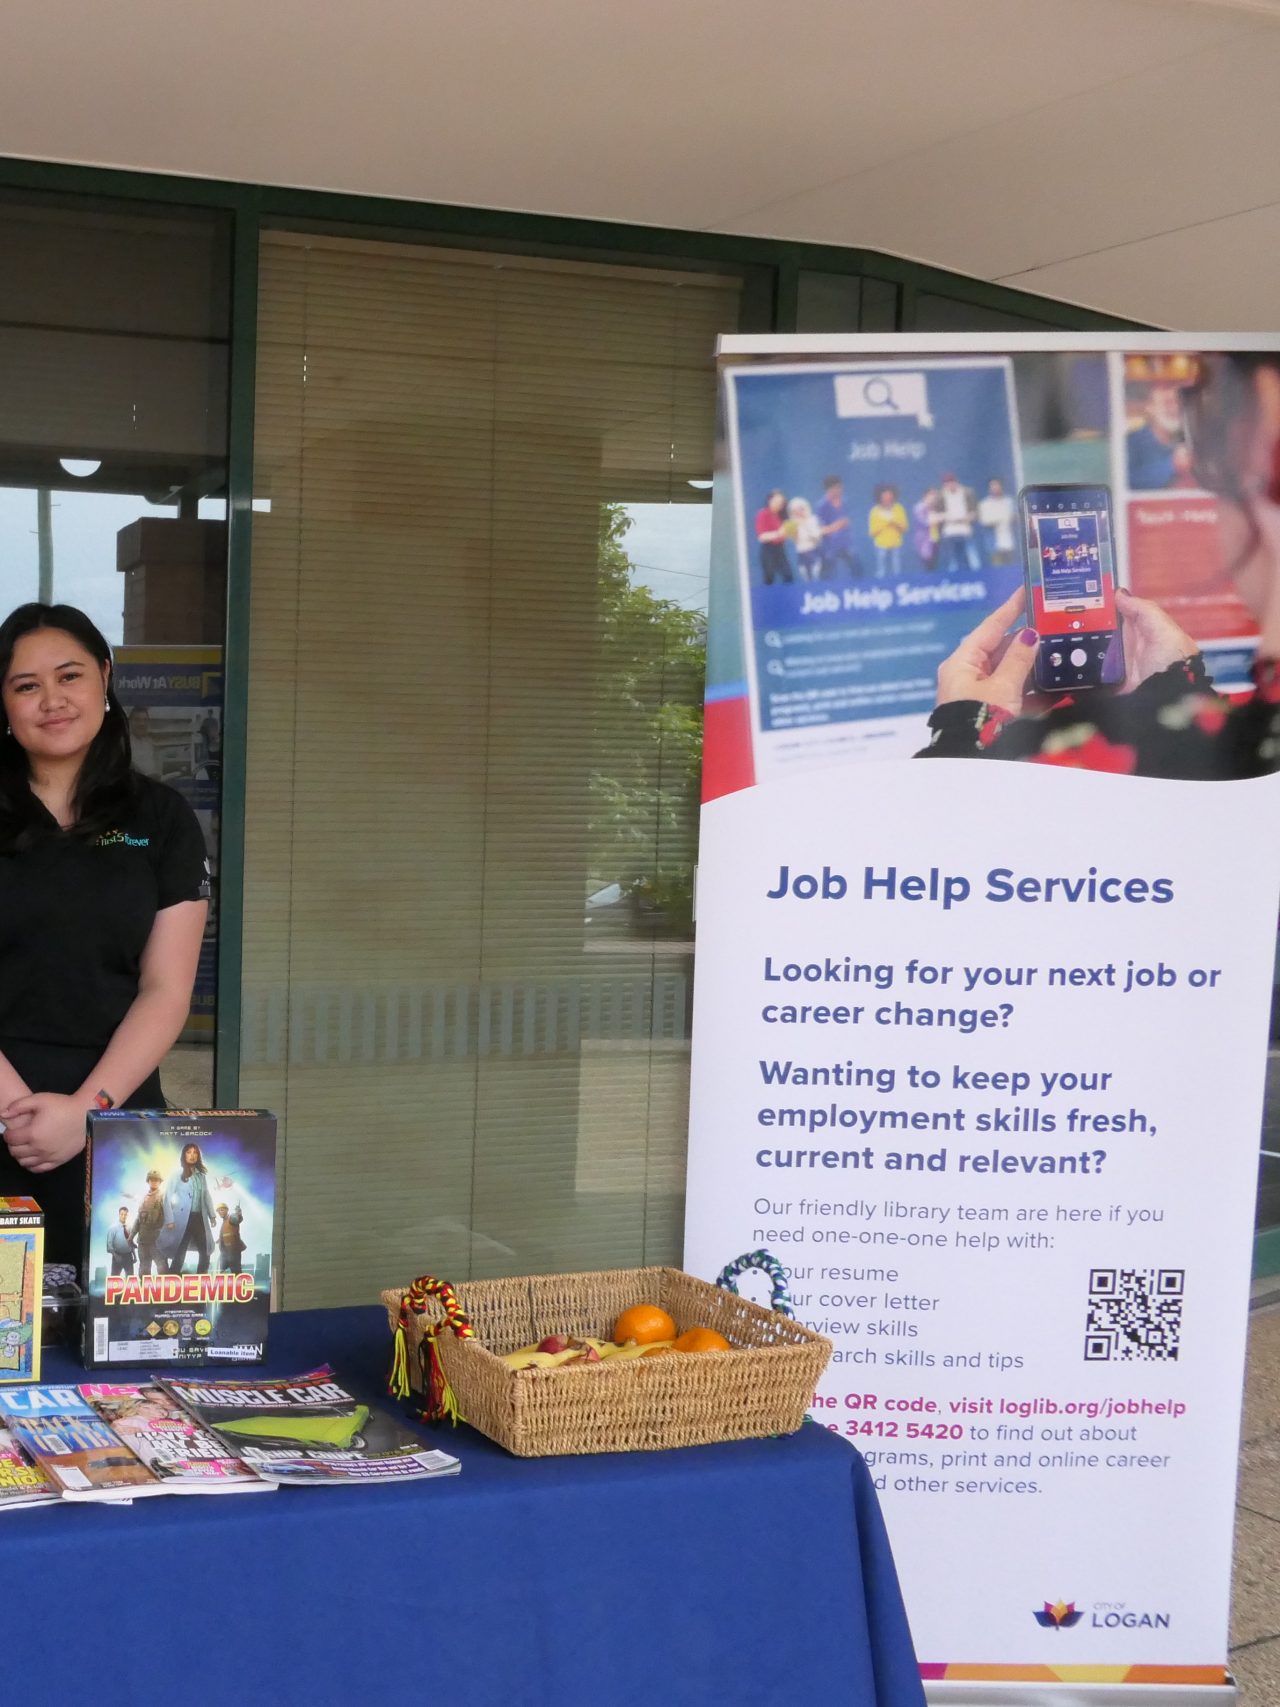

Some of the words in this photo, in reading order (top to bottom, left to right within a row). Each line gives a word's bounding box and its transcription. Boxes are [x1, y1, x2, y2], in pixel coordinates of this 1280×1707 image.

[848, 441, 885, 462] Job
[891, 439, 926, 461] Help
[800, 590, 840, 615] Job
[844, 587, 893, 611] Help
[896, 580, 987, 606] Services
[767, 866, 847, 899] Job
[864, 867, 970, 910] Help
[986, 867, 1173, 903] Services
[765, 957, 893, 989] Looking
[905, 960, 953, 984] for
[964, 967, 1038, 991] your
[1049, 964, 1115, 986] next
[1124, 961, 1176, 992] job
[1188, 969, 1221, 987] or
[762, 1005, 864, 1024] career
[875, 1002, 1013, 1033] change?
[759, 1061, 895, 1093] Wanting
[907, 1066, 940, 1088] to
[953, 1065, 1030, 1096] keep
[1041, 1073, 1112, 1096] your
[758, 1104, 965, 1134] employment
[976, 1106, 1056, 1132] skills
[1067, 1108, 1156, 1136] fresh,
[756, 1148, 874, 1169] current
[885, 1148, 946, 1171] and
[959, 1150, 1106, 1174] relevant?
[0, 1217, 17, 1225] BART
[19, 1216, 41, 1224] SKATE
[754, 1198, 792, 1214] Our
[799, 1199, 876, 1220] friendly
[885, 1201, 950, 1223] library
[957, 1205, 1008, 1220] team
[1017, 1209, 1048, 1221] are
[1057, 1205, 1101, 1221] here
[1110, 1205, 1122, 1221] if
[1127, 1210, 1163, 1225] you
[753, 1226, 804, 1242] need
[812, 1231, 947, 1246] one-one-one
[956, 1232, 999, 1251] help
[1007, 1232, 1054, 1248] with:
[821, 1268, 898, 1282] resume
[105, 1273, 254, 1305] PANDEMIC
[820, 1295, 877, 1307] cover
[885, 1293, 939, 1310] letter
[867, 1320, 917, 1337] skills
[885, 1350, 935, 1366] skills
[943, 1352, 981, 1367] and
[989, 1352, 1023, 1371] tips
[0, 1389, 86, 1411] CAR
[171, 1385, 292, 1404] MUSCLE
[286, 1383, 355, 1402] CAR
[810, 1393, 837, 1408] he
[845, 1394, 877, 1409] QR
[885, 1397, 941, 1413] code,
[950, 1397, 993, 1413] visit
[1000, 1398, 1185, 1418] loglib.org/jobhelp
[843, 1420, 898, 1436] 3412
[906, 1423, 963, 1439] 5420
[970, 1426, 989, 1440] to
[997, 1425, 1033, 1440] find
[1041, 1427, 1072, 1440] out
[1080, 1426, 1136, 1440] about
[151, 1439, 187, 1449] MY
[942, 1451, 987, 1469] print
[994, 1452, 1031, 1467] and
[1039, 1452, 1099, 1467] online
[1106, 1455, 1170, 1467] career
[894, 1476, 948, 1492] other
[955, 1478, 1042, 1493] services.
[1093, 1602, 1112, 1610] CITY
[1092, 1612, 1170, 1628] LOGAN
